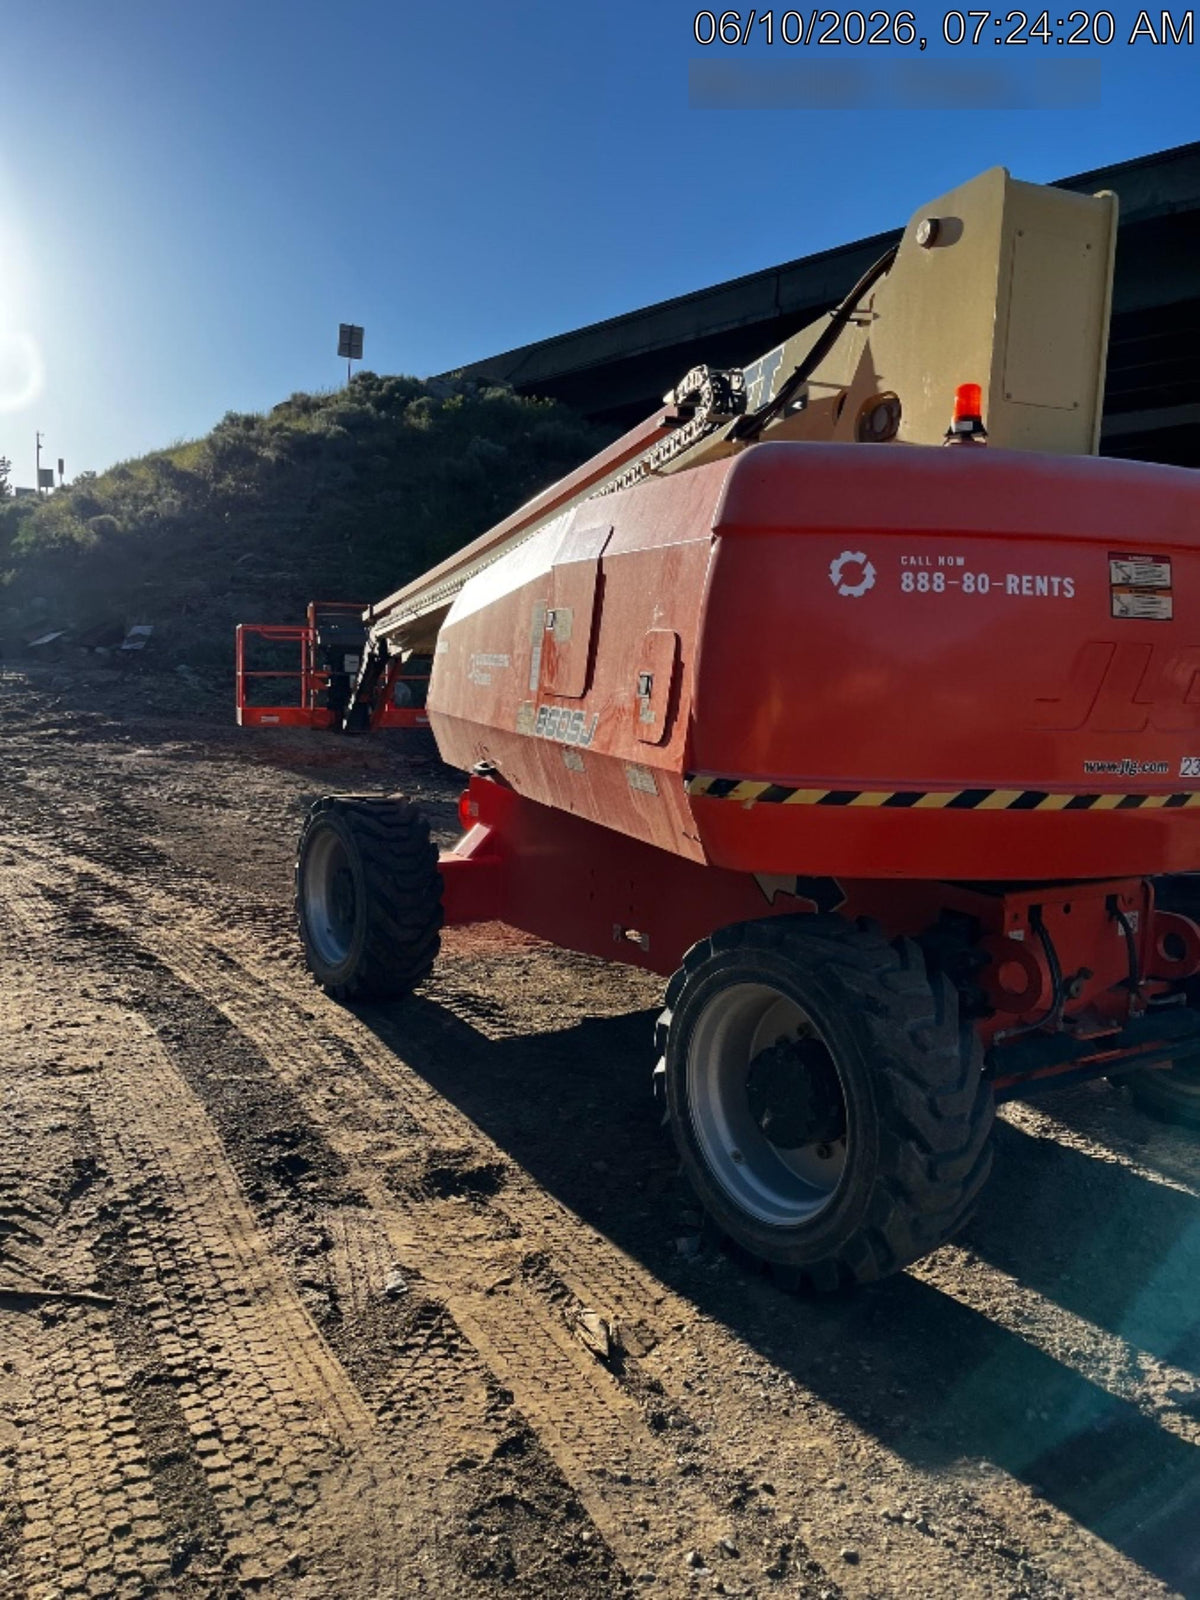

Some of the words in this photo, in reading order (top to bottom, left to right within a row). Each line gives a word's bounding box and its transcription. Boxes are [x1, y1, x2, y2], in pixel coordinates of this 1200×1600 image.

[900, 556, 932, 566] CALL
[938, 556, 965, 566] NOW
[900, 571, 1076, 598] 888-80-RENTS
[1084, 759, 1168, 776] www.jlg.com
